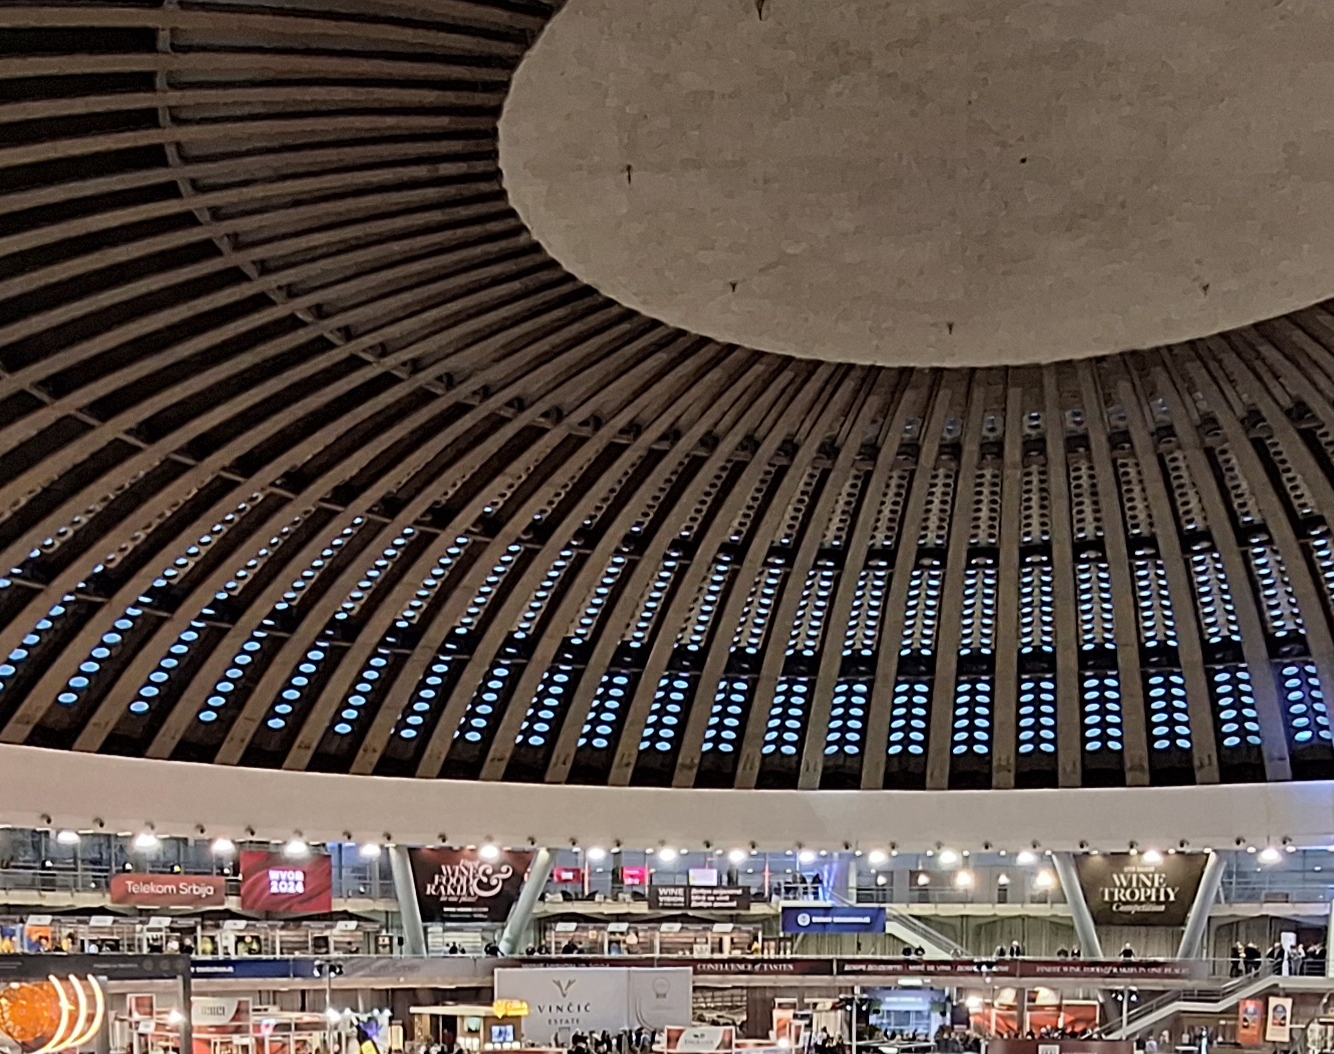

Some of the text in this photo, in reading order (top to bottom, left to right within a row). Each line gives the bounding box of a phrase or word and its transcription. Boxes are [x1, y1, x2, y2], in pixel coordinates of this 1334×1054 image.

[1112, 873, 1167, 887] WINE
[125, 880, 215, 898] Telekom Srbija
[270, 881, 305, 894] 2024
[658, 888, 685, 896] WINE
[1099, 887, 1180, 901] TROPHY
[537, 1002, 591, 1013] VINČIĆ
